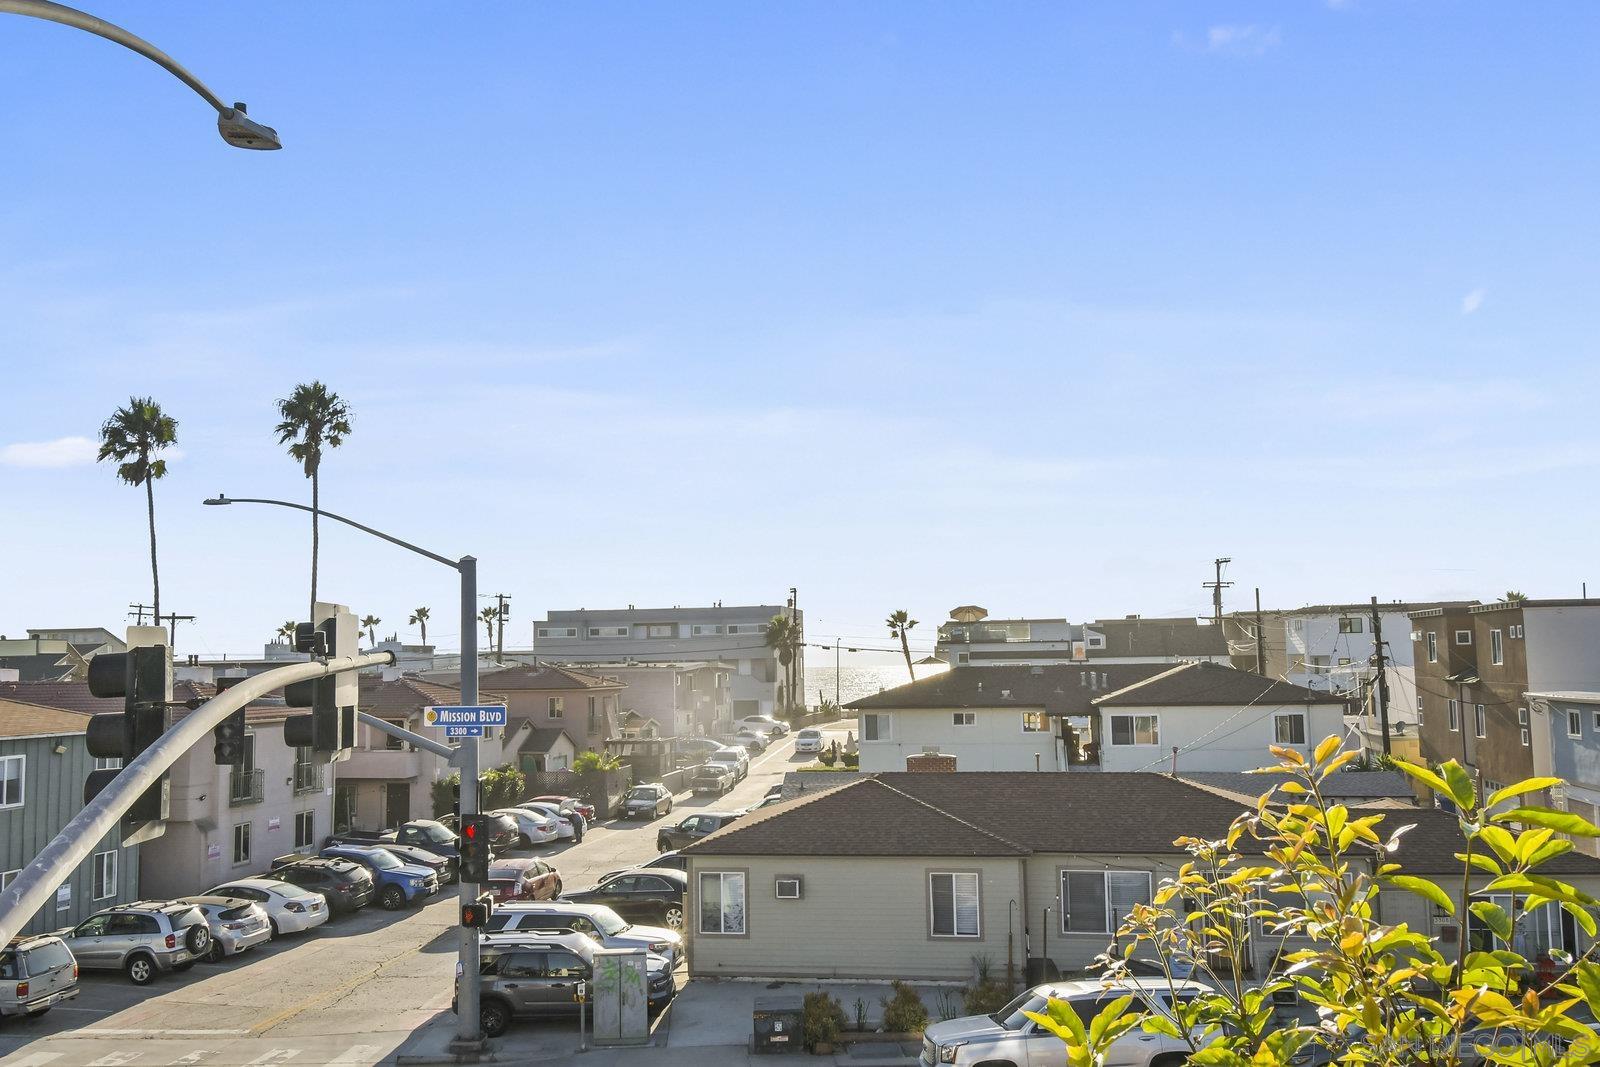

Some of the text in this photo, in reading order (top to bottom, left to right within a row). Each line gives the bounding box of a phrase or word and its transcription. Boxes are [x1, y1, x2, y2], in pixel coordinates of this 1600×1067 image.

[440, 710, 502, 723] MISSION BLVD
[449, 727, 468, 736] 3300
